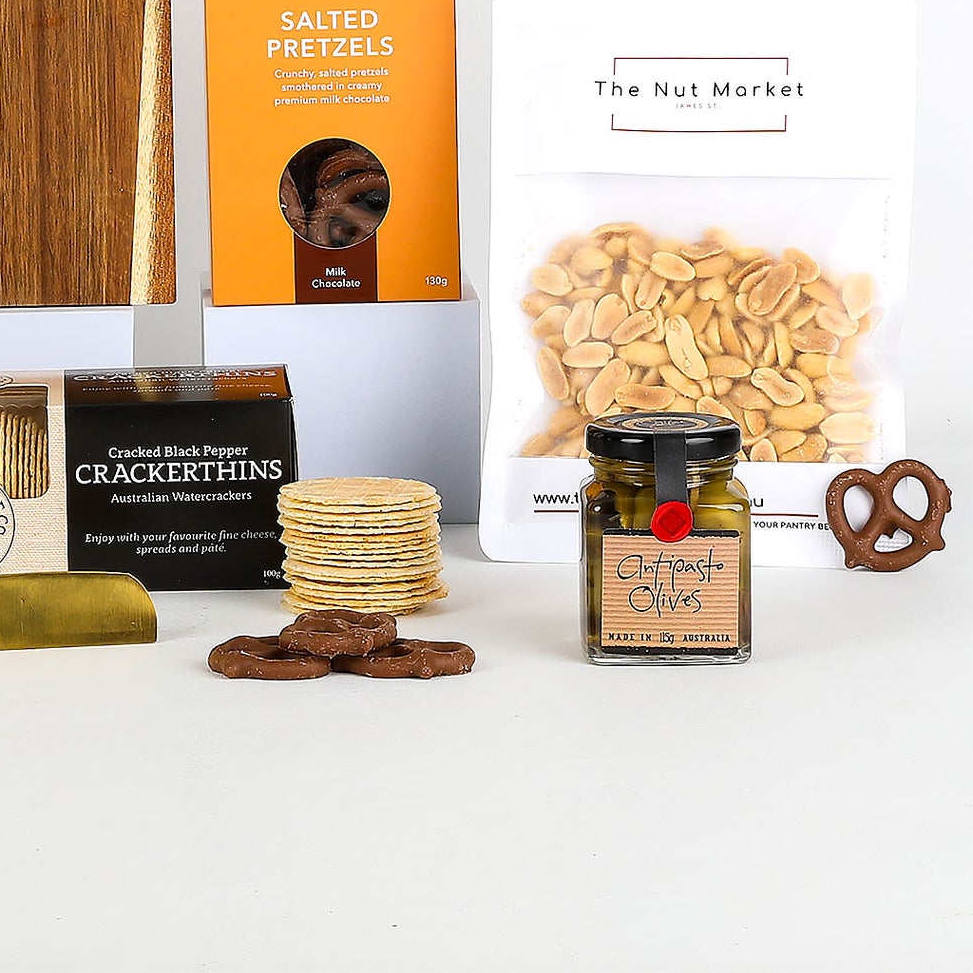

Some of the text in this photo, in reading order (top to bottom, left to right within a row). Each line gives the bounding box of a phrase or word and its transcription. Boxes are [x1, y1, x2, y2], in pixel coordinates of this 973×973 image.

[280, 9, 379, 32] SALTED
[267, 36, 394, 59] PRETZELS
[274, 66, 389, 80] Crunchy, salted pretzels
[281, 81, 383, 92] smothered in creamy
[594, 80, 804, 97] The Nut Market
[274, 94, 390, 107] premium milk chocolate
[325, 267, 347, 277] Milk
[311, 278, 361, 289] Chocolate
[425, 276, 448, 287] 130g
[108, 445, 249, 459] Cracked Black Pepper
[76, 459, 283, 485] CRACKERTHINS
[110, 490, 252, 504] Australian Watercrackers
[780, 522, 816, 530] PANTRY
[85, 529, 277, 545] Enjoy with your favourite fine cheese,
[135, 544, 177, 556] spreads
[178, 543, 199, 553] and
[263, 570, 281, 579] 100g
[628, 582, 702, 618] Olives
[608, 633, 635, 641] MADE
[641, 633, 652, 642] IN
[682, 633, 731, 642] AUSTRALIA
